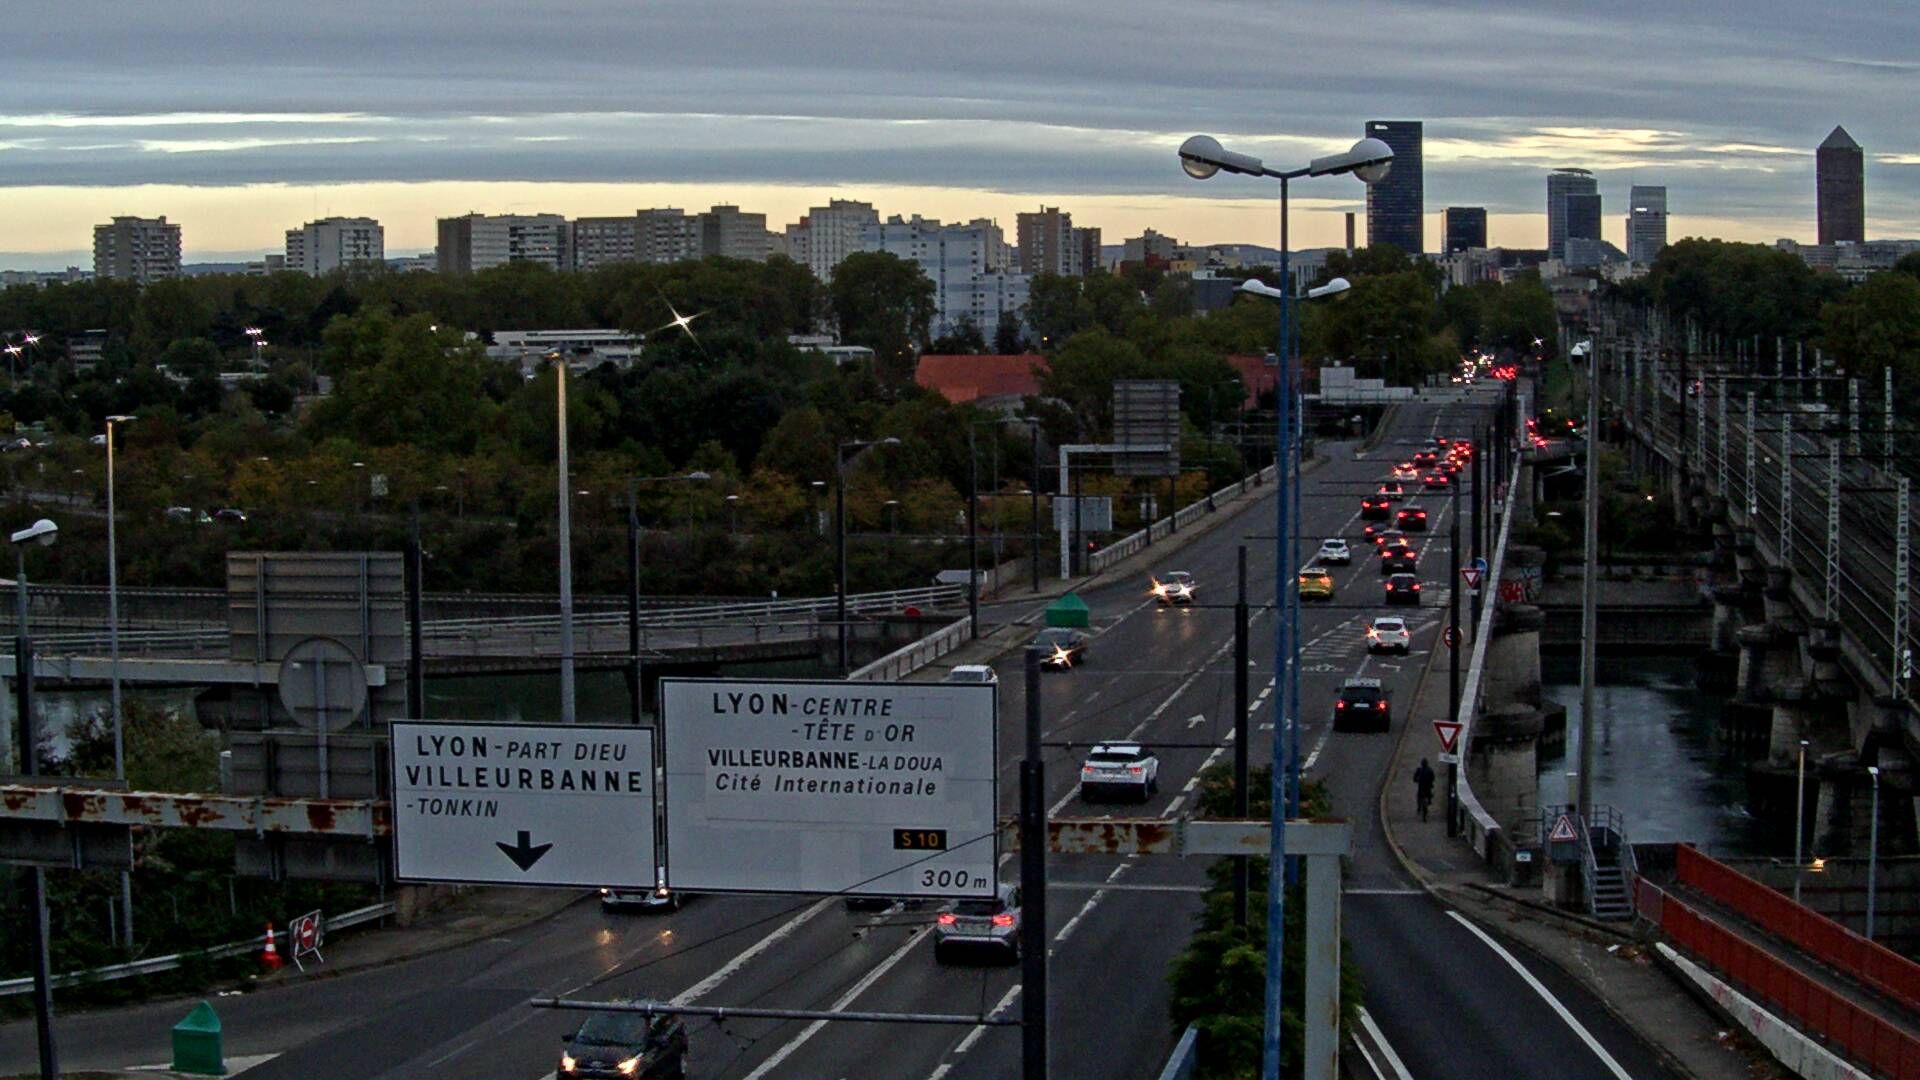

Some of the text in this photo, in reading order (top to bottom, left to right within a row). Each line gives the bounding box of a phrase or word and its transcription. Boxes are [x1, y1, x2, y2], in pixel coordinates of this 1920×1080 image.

[713, 693, 893, 717] LYON-CENTRE
[575, 743, 627, 761] DIEU
[894, 757, 943, 771] DOUA
[406, 766, 643, 792] VILLEURBANNE
[715, 773, 936, 795] Cité Internationale
[406, 799, 499, 817] -TONKIN
[901, 832, 939, 848] S 10
[922, 869, 987, 888] 300 m
